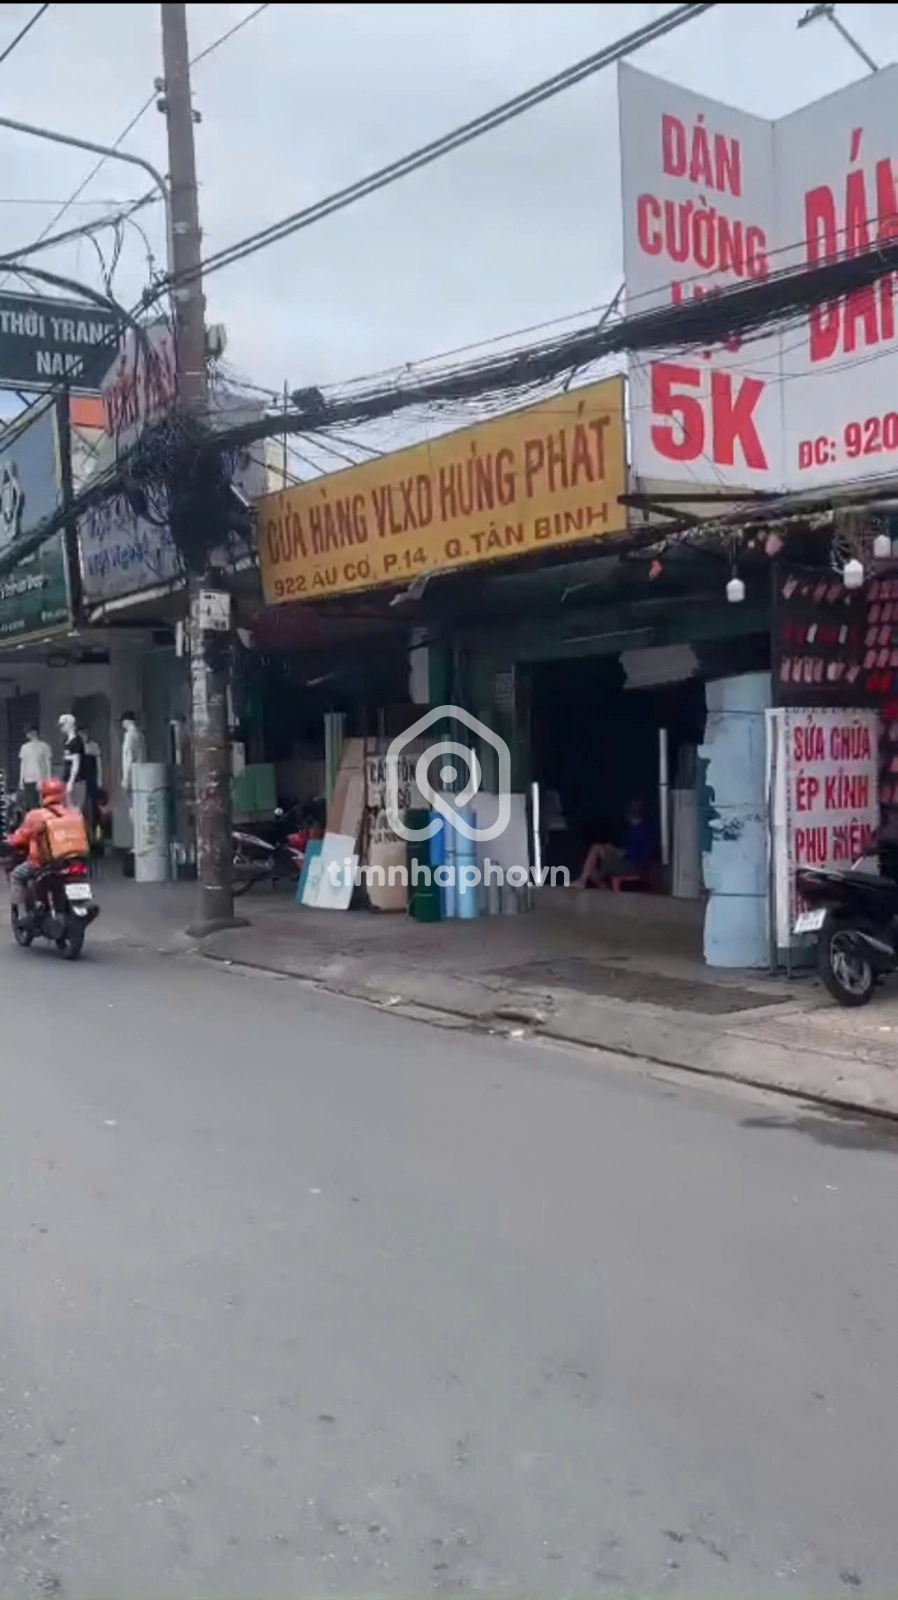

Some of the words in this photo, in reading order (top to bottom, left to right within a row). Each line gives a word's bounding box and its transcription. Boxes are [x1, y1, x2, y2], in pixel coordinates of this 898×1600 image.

[662, 113, 742, 197] DÁN
[637, 192, 769, 283] CƯỜNG
[0, 308, 45, 338] THỜI
[36, 350, 84, 378] NAM
[651, 361, 768, 470] 5K
[843, 411, 898, 458] 920
[267, 493, 308, 565] CỬA
[309, 486, 368, 555] HÀNG
[372, 473, 434, 539] VLXD
[438, 440, 516, 522] HƯNG
[524, 400, 612, 499] PHÁT
[274, 575, 307, 598] 922
[793, 714, 825, 762] SỬA
[795, 768, 819, 812] ÉP
[825, 767, 869, 810] KÍNH
[795, 825, 828, 869] PHỤ
